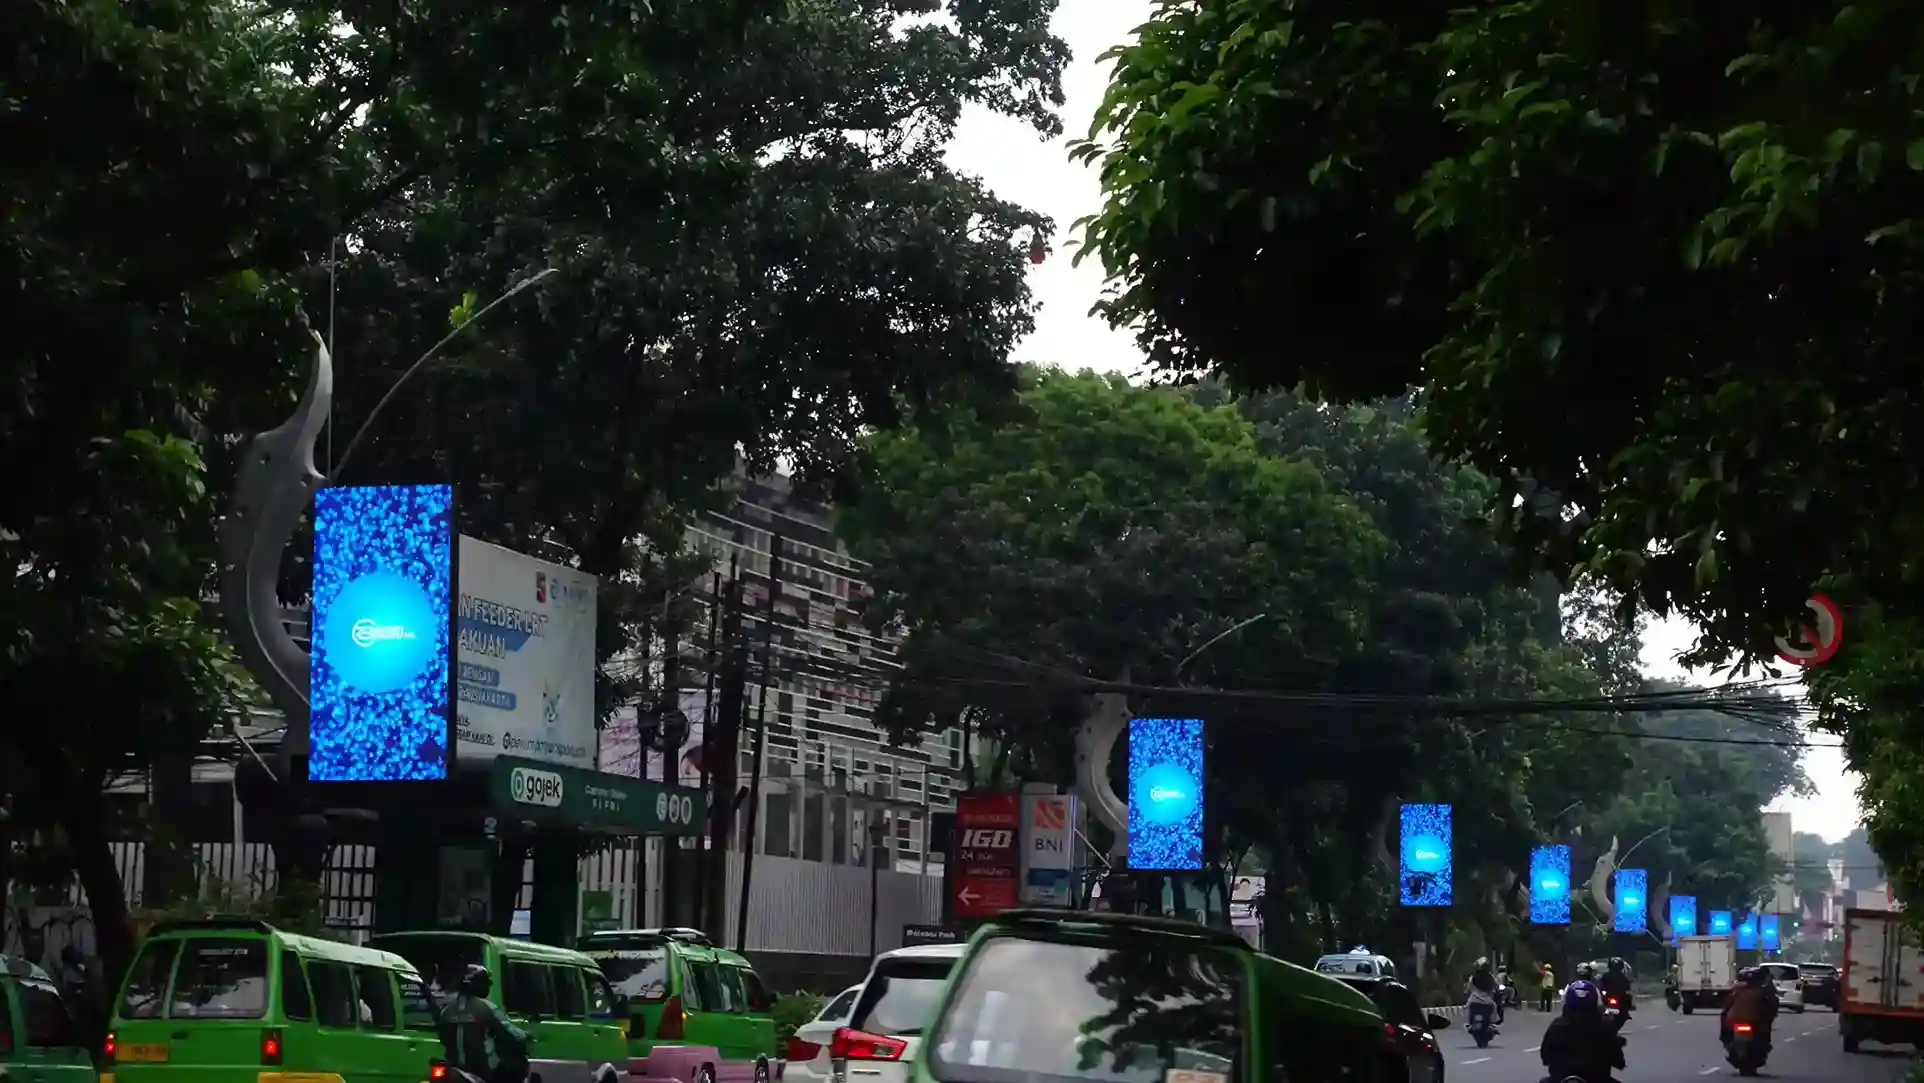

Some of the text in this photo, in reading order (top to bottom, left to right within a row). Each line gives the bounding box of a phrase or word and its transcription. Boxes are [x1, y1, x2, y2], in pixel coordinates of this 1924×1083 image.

[474, 597, 523, 632] FEEDER
[459, 627, 506, 660] AKUAN
[526, 775, 560, 802] gojek
[961, 829, 1012, 849] IGD
[1035, 838, 1063, 853] BNI
